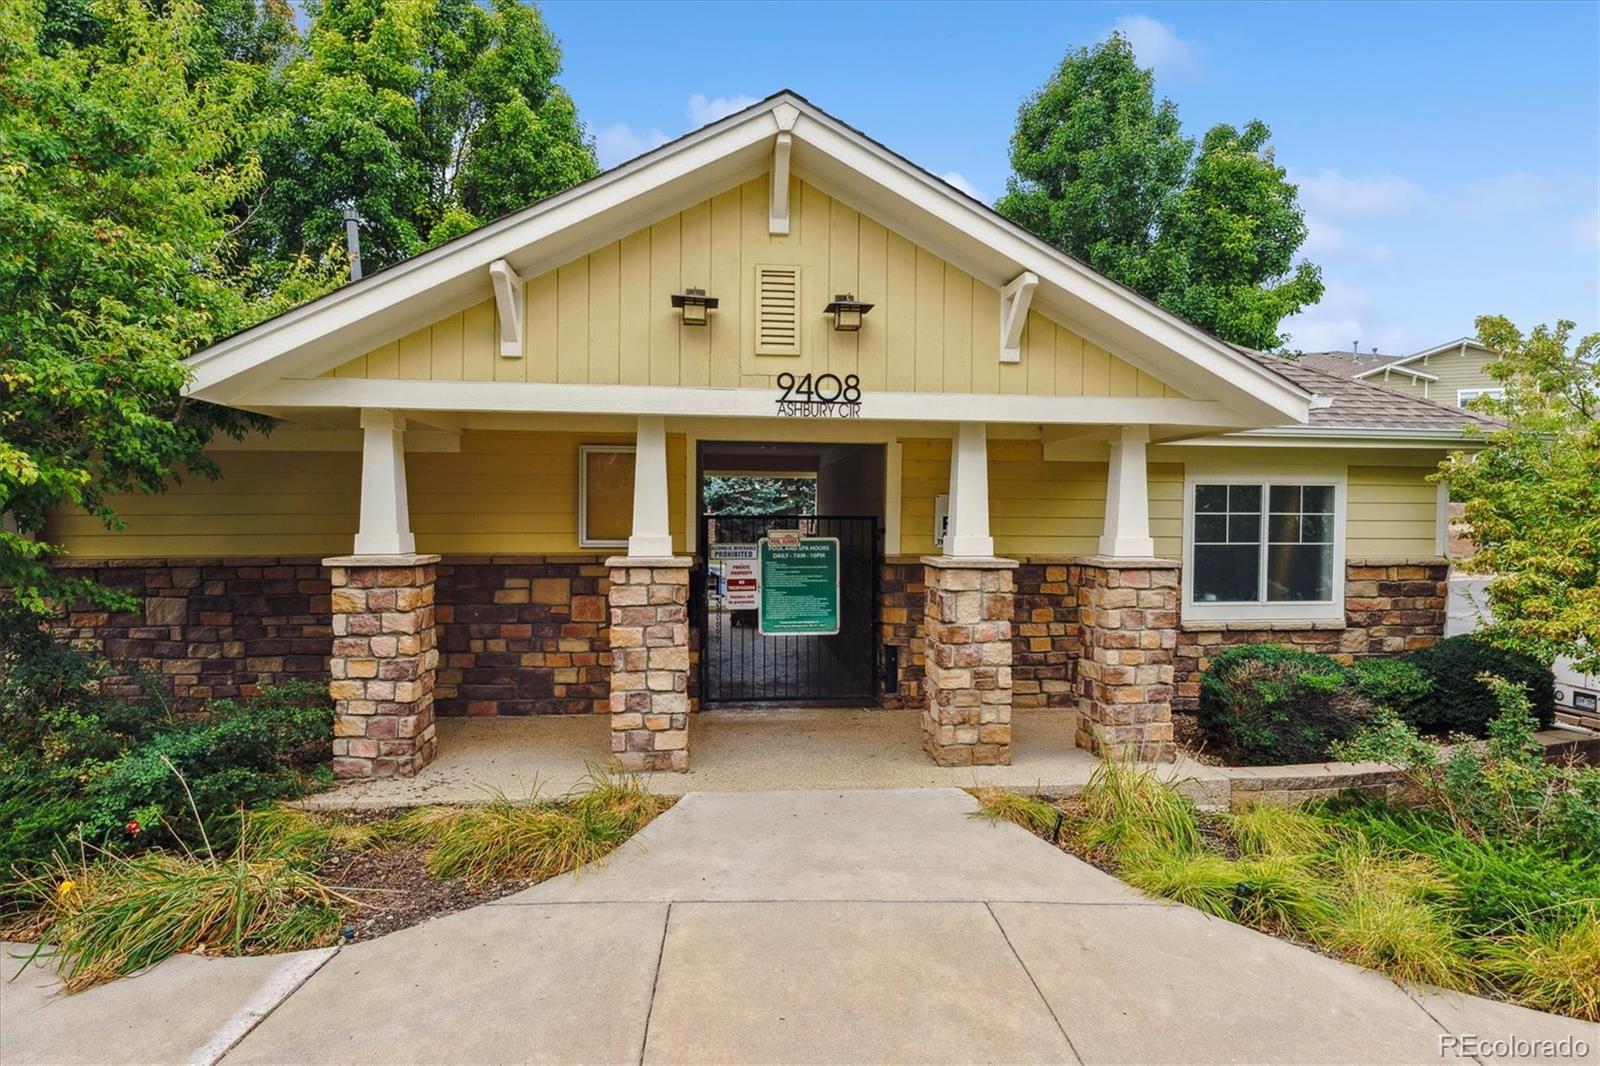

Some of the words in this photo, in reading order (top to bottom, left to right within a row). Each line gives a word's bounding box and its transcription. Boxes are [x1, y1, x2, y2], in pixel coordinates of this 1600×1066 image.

[776, 372, 861, 402] 9408
[777, 402, 835, 417] ASHBURY
[838, 403, 861, 418] CIR
